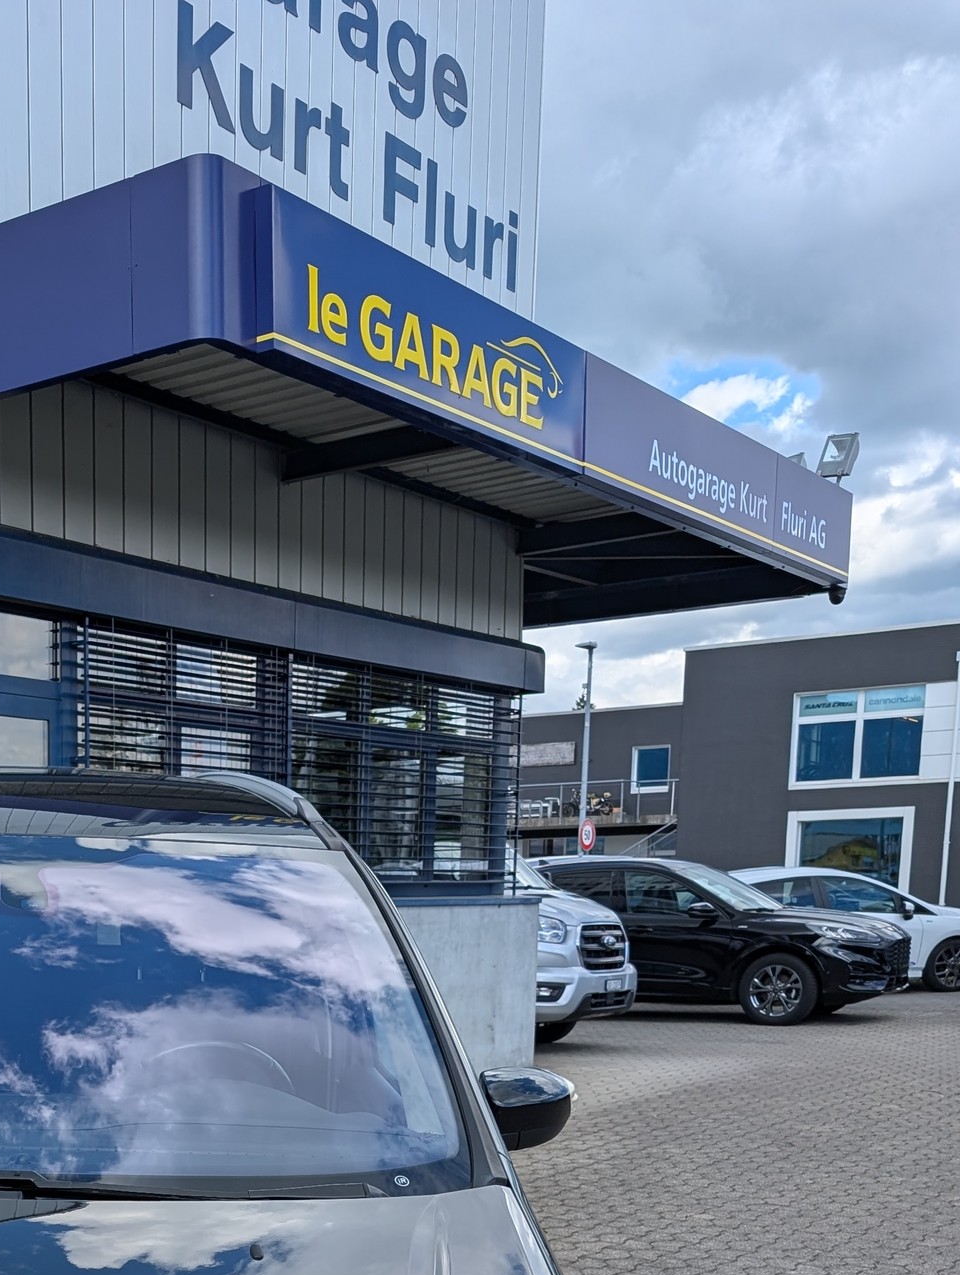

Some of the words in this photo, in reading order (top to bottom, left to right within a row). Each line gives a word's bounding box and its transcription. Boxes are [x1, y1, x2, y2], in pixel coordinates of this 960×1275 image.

[266, 0, 468, 128] age
[177, 0, 350, 201] Kurt
[383, 131, 518, 293] Fluri
[307, 263, 348, 346] le
[359, 294, 545, 430] GARAGE
[648, 439, 736, 514] Autogarage
[739, 480, 768, 523] Kurt
[781, 501, 807, 540] Fluri
[808, 515, 827, 549] AG
[803, 702, 831, 710] SANTA
[868, 694, 922, 706] cannondale
[583, 829, 591, 841] 50
